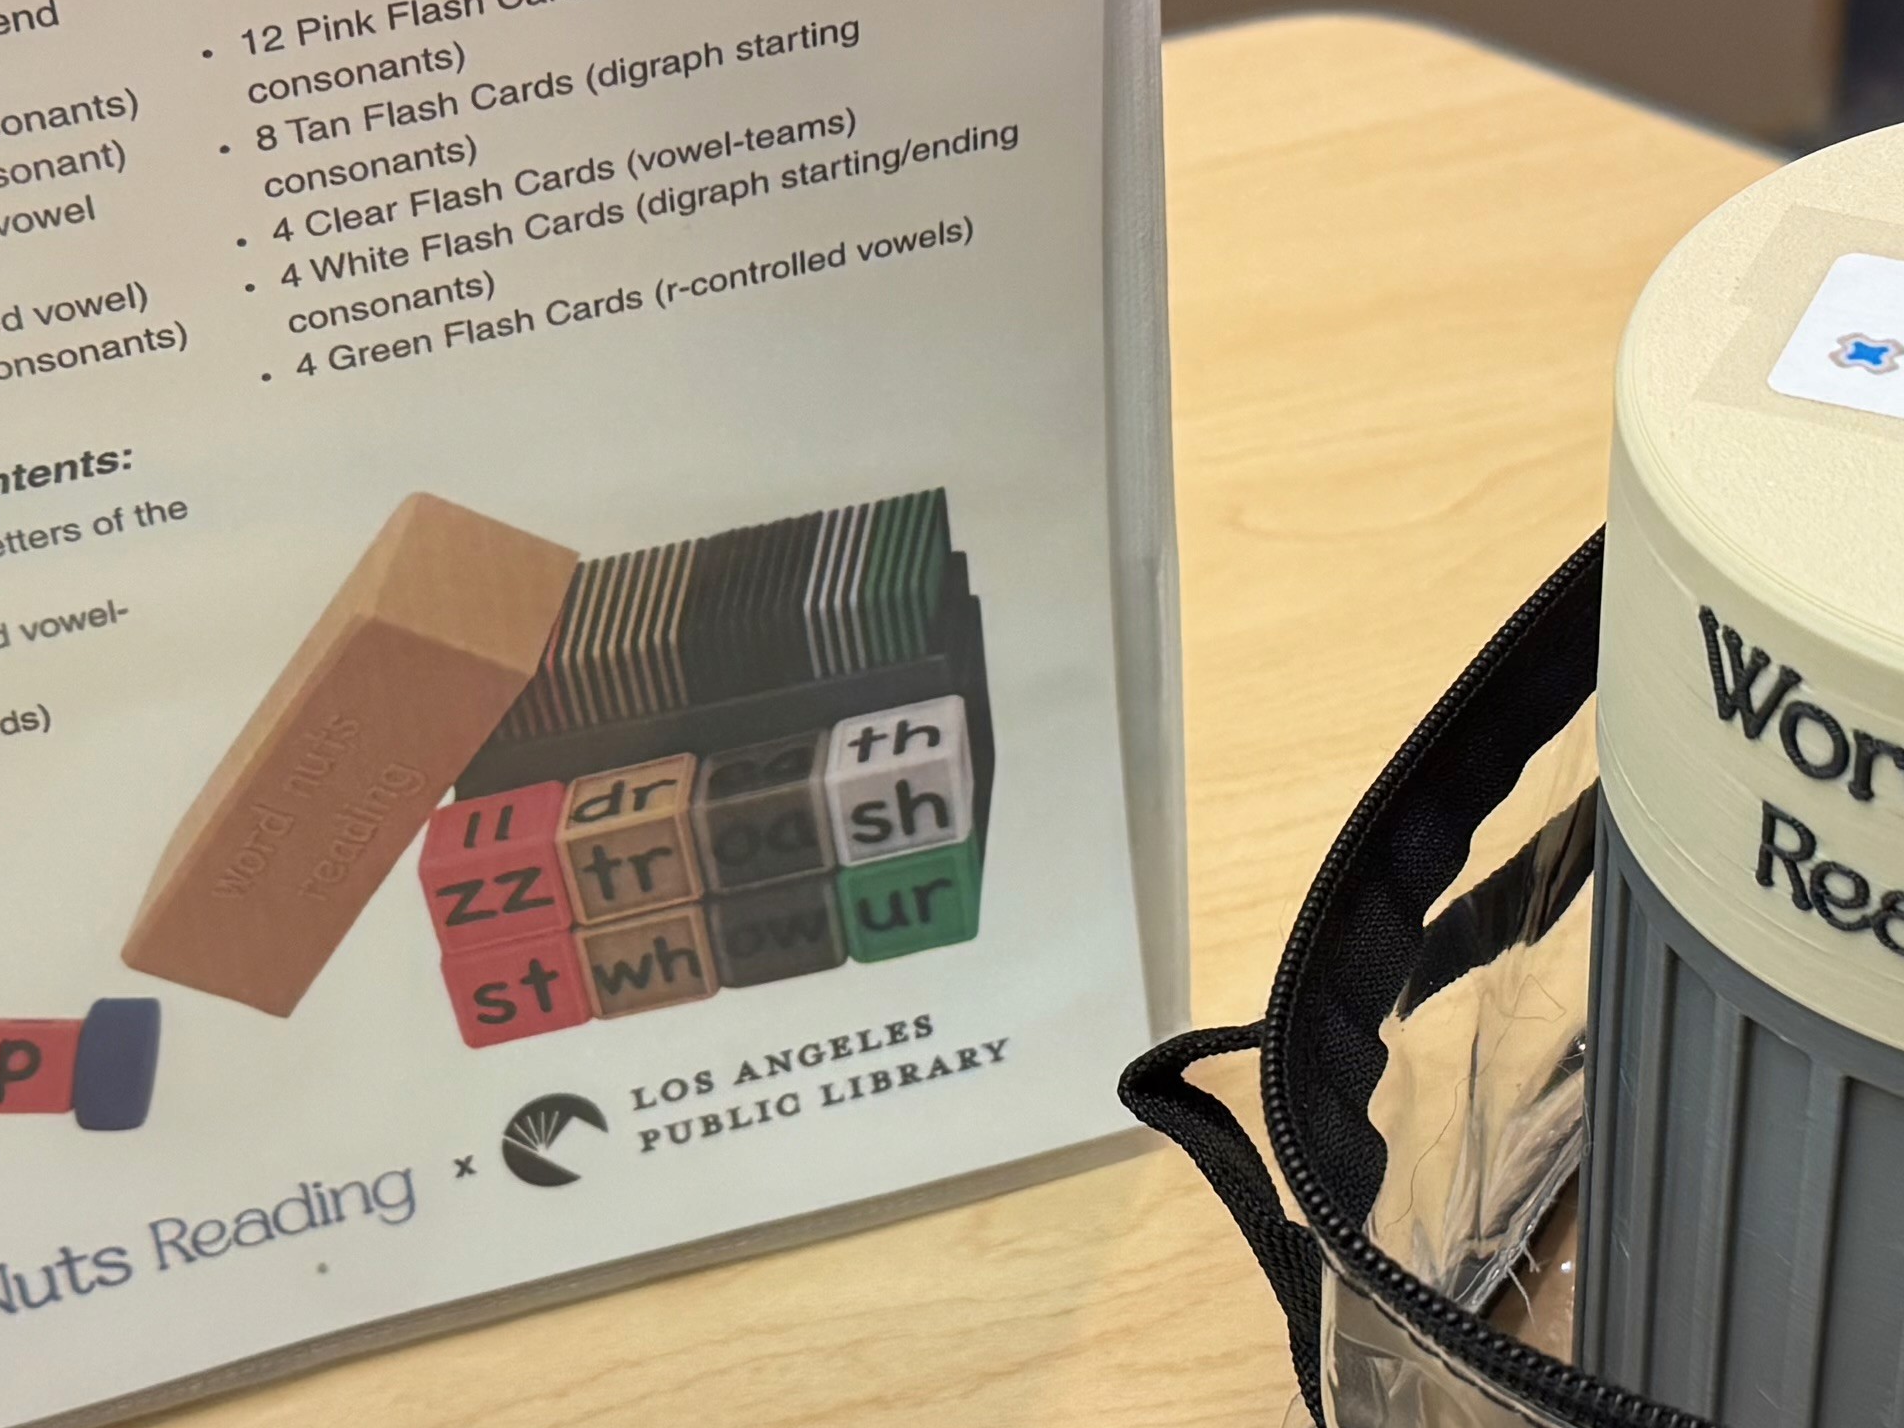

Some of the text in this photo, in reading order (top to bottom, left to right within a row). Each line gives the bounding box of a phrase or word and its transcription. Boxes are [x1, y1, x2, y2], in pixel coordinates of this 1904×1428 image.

[295, 214, 975, 377] 4 Green Flash Cards (r-controlled vowels)
[91, 505, 125, 537] of
[132, 499, 190, 529] the
[847, 717, 944, 765] th
[296, 760, 426, 905] reading
[571, 775, 680, 826] dr
[848, 778, 951, 843] sh
[581, 836, 674, 902] tr
[855, 872, 955, 936] ur
[472, 955, 561, 1029] st
[592, 935, 703, 999] wh
[629, 1013, 935, 1113] LOS ANGELES
[637, 1036, 1009, 1155] PUBLIC LIBRARY
[452, 1154, 478, 1180] x
[147, 1166, 417, 1273] Reading
